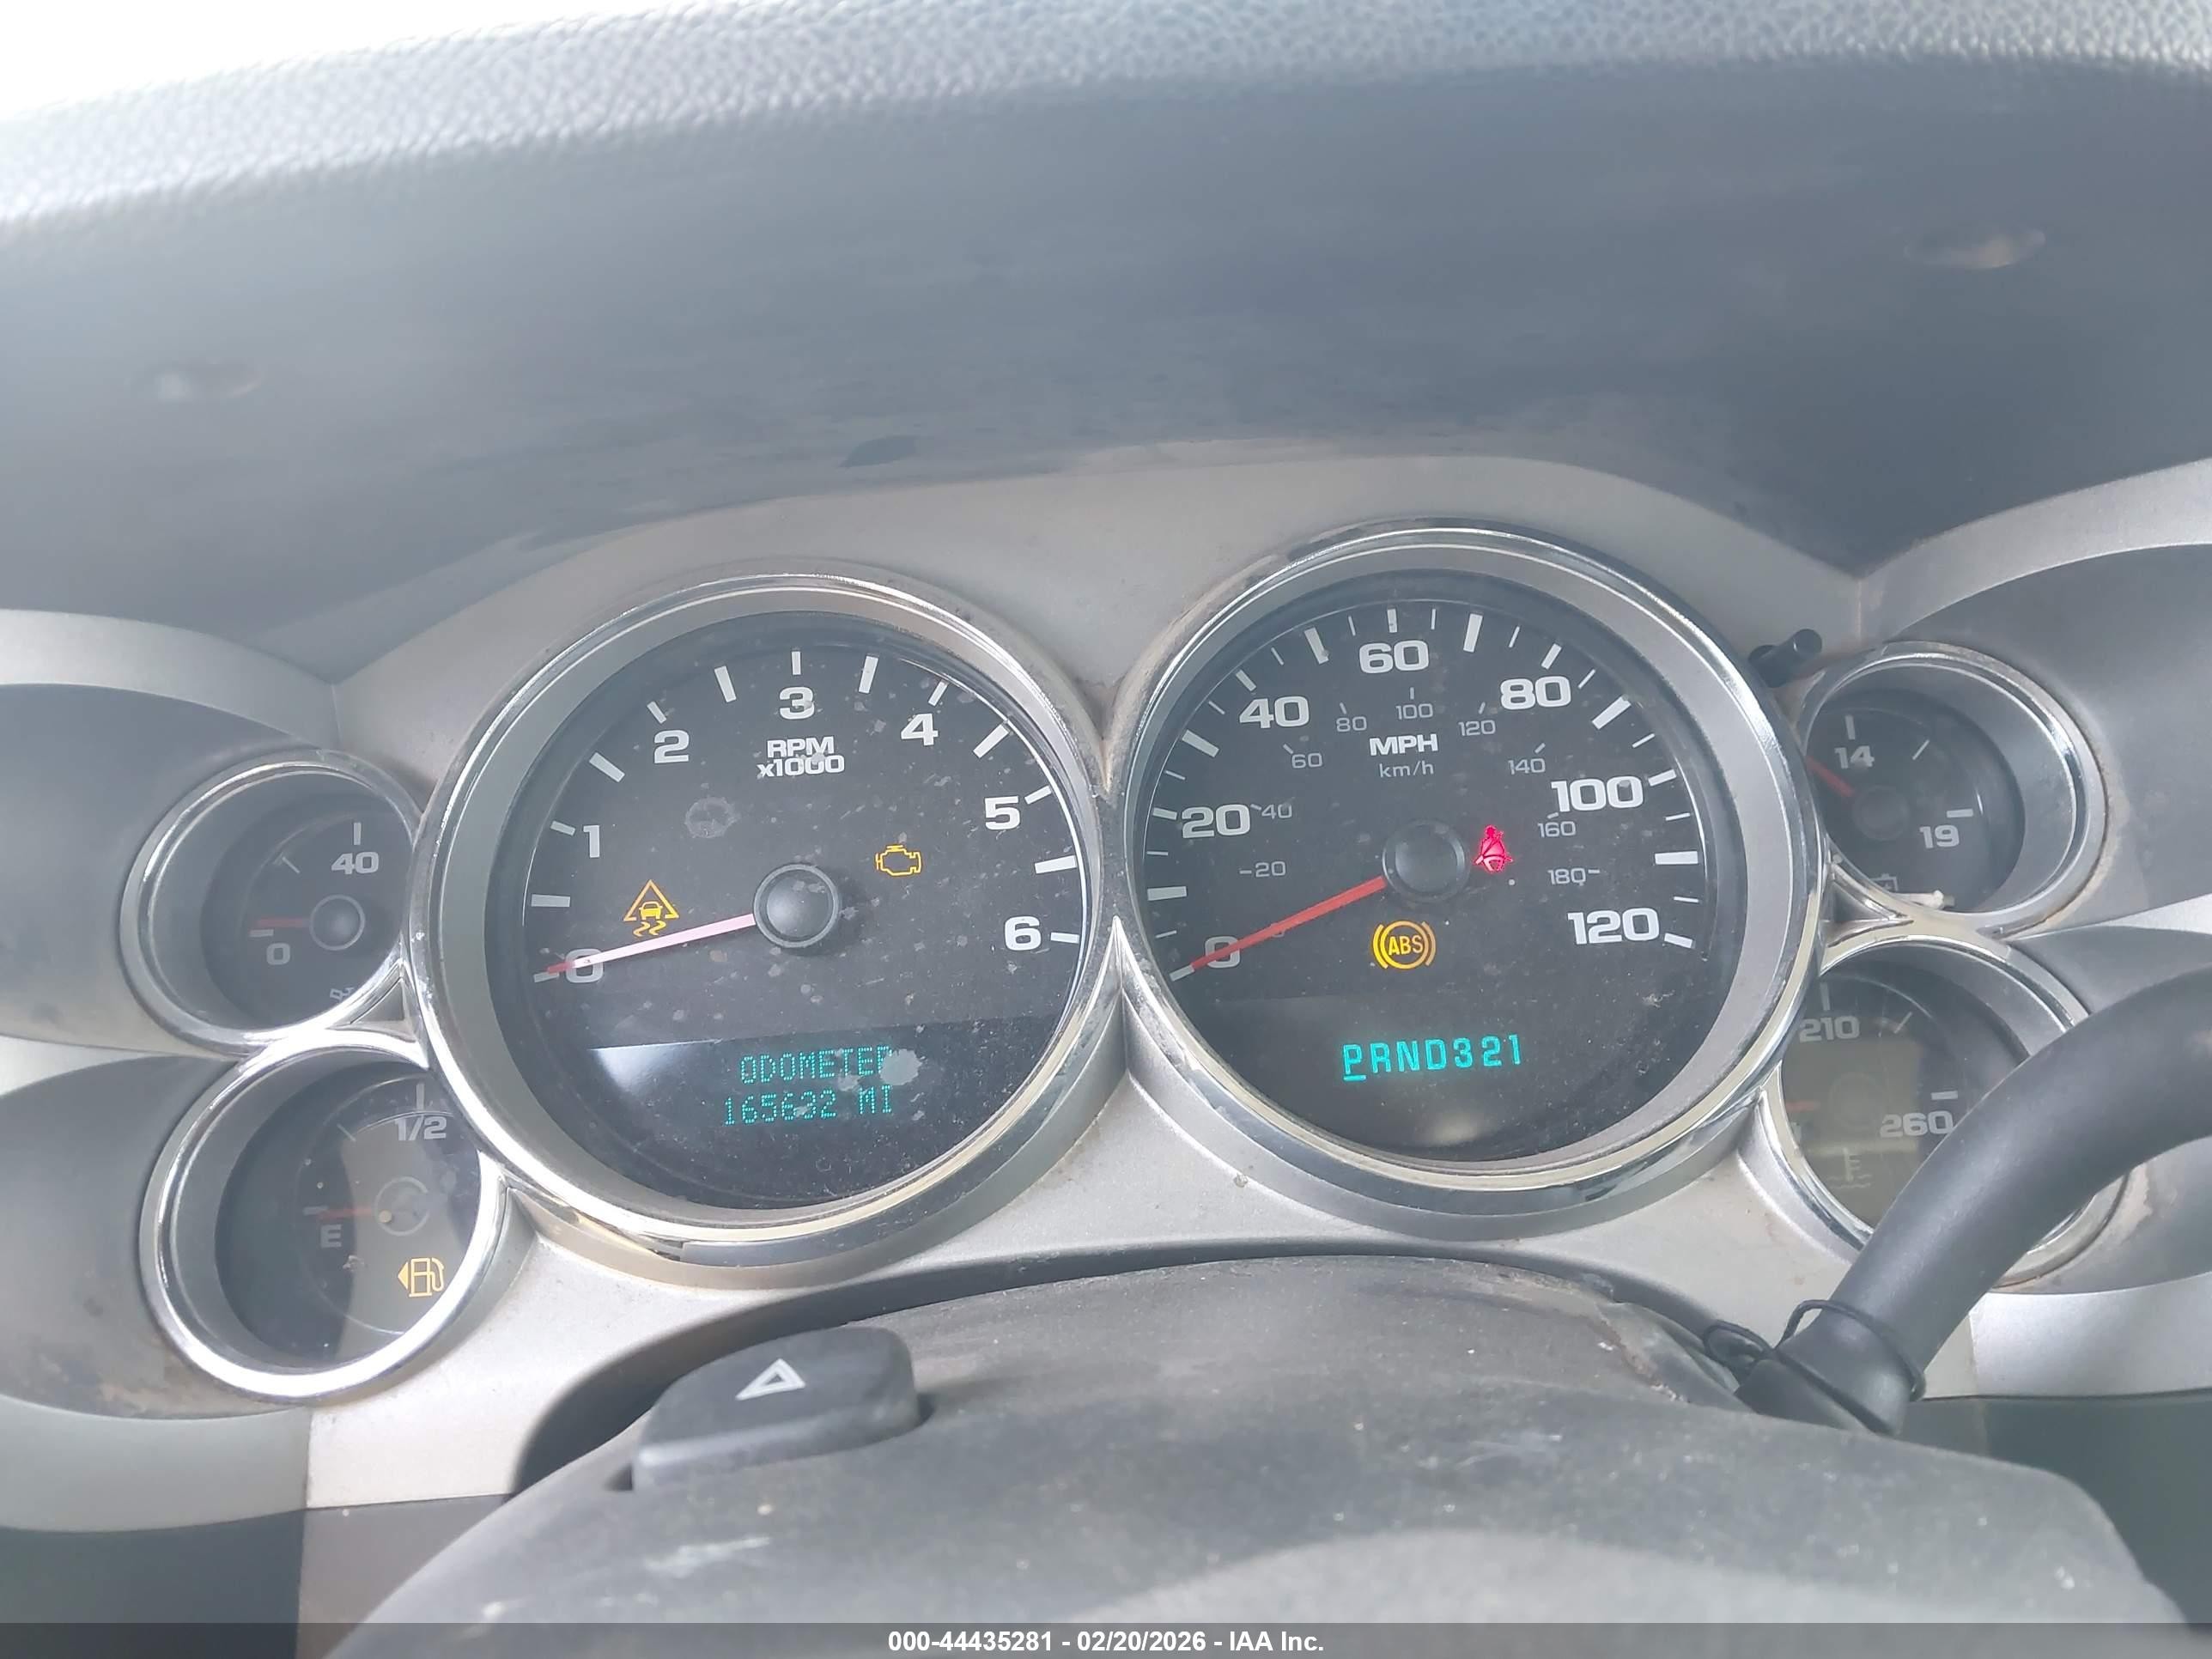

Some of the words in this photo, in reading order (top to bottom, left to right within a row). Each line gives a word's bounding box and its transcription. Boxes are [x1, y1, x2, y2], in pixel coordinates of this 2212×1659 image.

[1359, 641, 1429, 673] 60
[779, 686, 814, 720] 3
[1500, 676, 1571, 710] 80
[1239, 696, 1309, 728] 40
[1395, 703, 1433, 720] 100
[901, 714, 938, 745] 4
[1336, 716, 1367, 733] 80
[1459, 719, 1496, 736] 120
[654, 730, 689, 763] 2
[767, 736, 834, 757] RPM
[1370, 733, 1437, 756] MPH
[757, 754, 845, 778] x1000
[1291, 752, 1322, 769] 60
[1379, 759, 1434, 777] km/h
[1508, 757, 1546, 775] 140
[1834, 745, 1875, 769] 14
[1551, 775, 1644, 812] 100
[984, 796, 1020, 830] 5
[1181, 804, 1250, 839] 20
[1261, 803, 1292, 819] 40
[582, 824, 599, 857] 1
[1538, 820, 1576, 837] 160
[1919, 824, 1960, 848] 19
[331, 852, 379, 874] 40
[1252, 861, 1286, 878] 20
[1547, 868, 1586, 885] 180
[1004, 915, 1040, 951] 6
[1567, 908, 1659, 945] 120
[266, 943, 290, 965] 0
[1205, 936, 1240, 968] 0
[1388, 935, 1424, 956] ABS
[564, 948, 604, 983] 0
[1799, 1016, 1860, 1042] 210
[723, 1088, 837, 1126] 165632
[859, 1085, 891, 1114] MI
[394, 1116, 447, 1141] 1/2
[1880, 1110, 1954, 1139] 260
[320, 1224, 342, 1248] E
